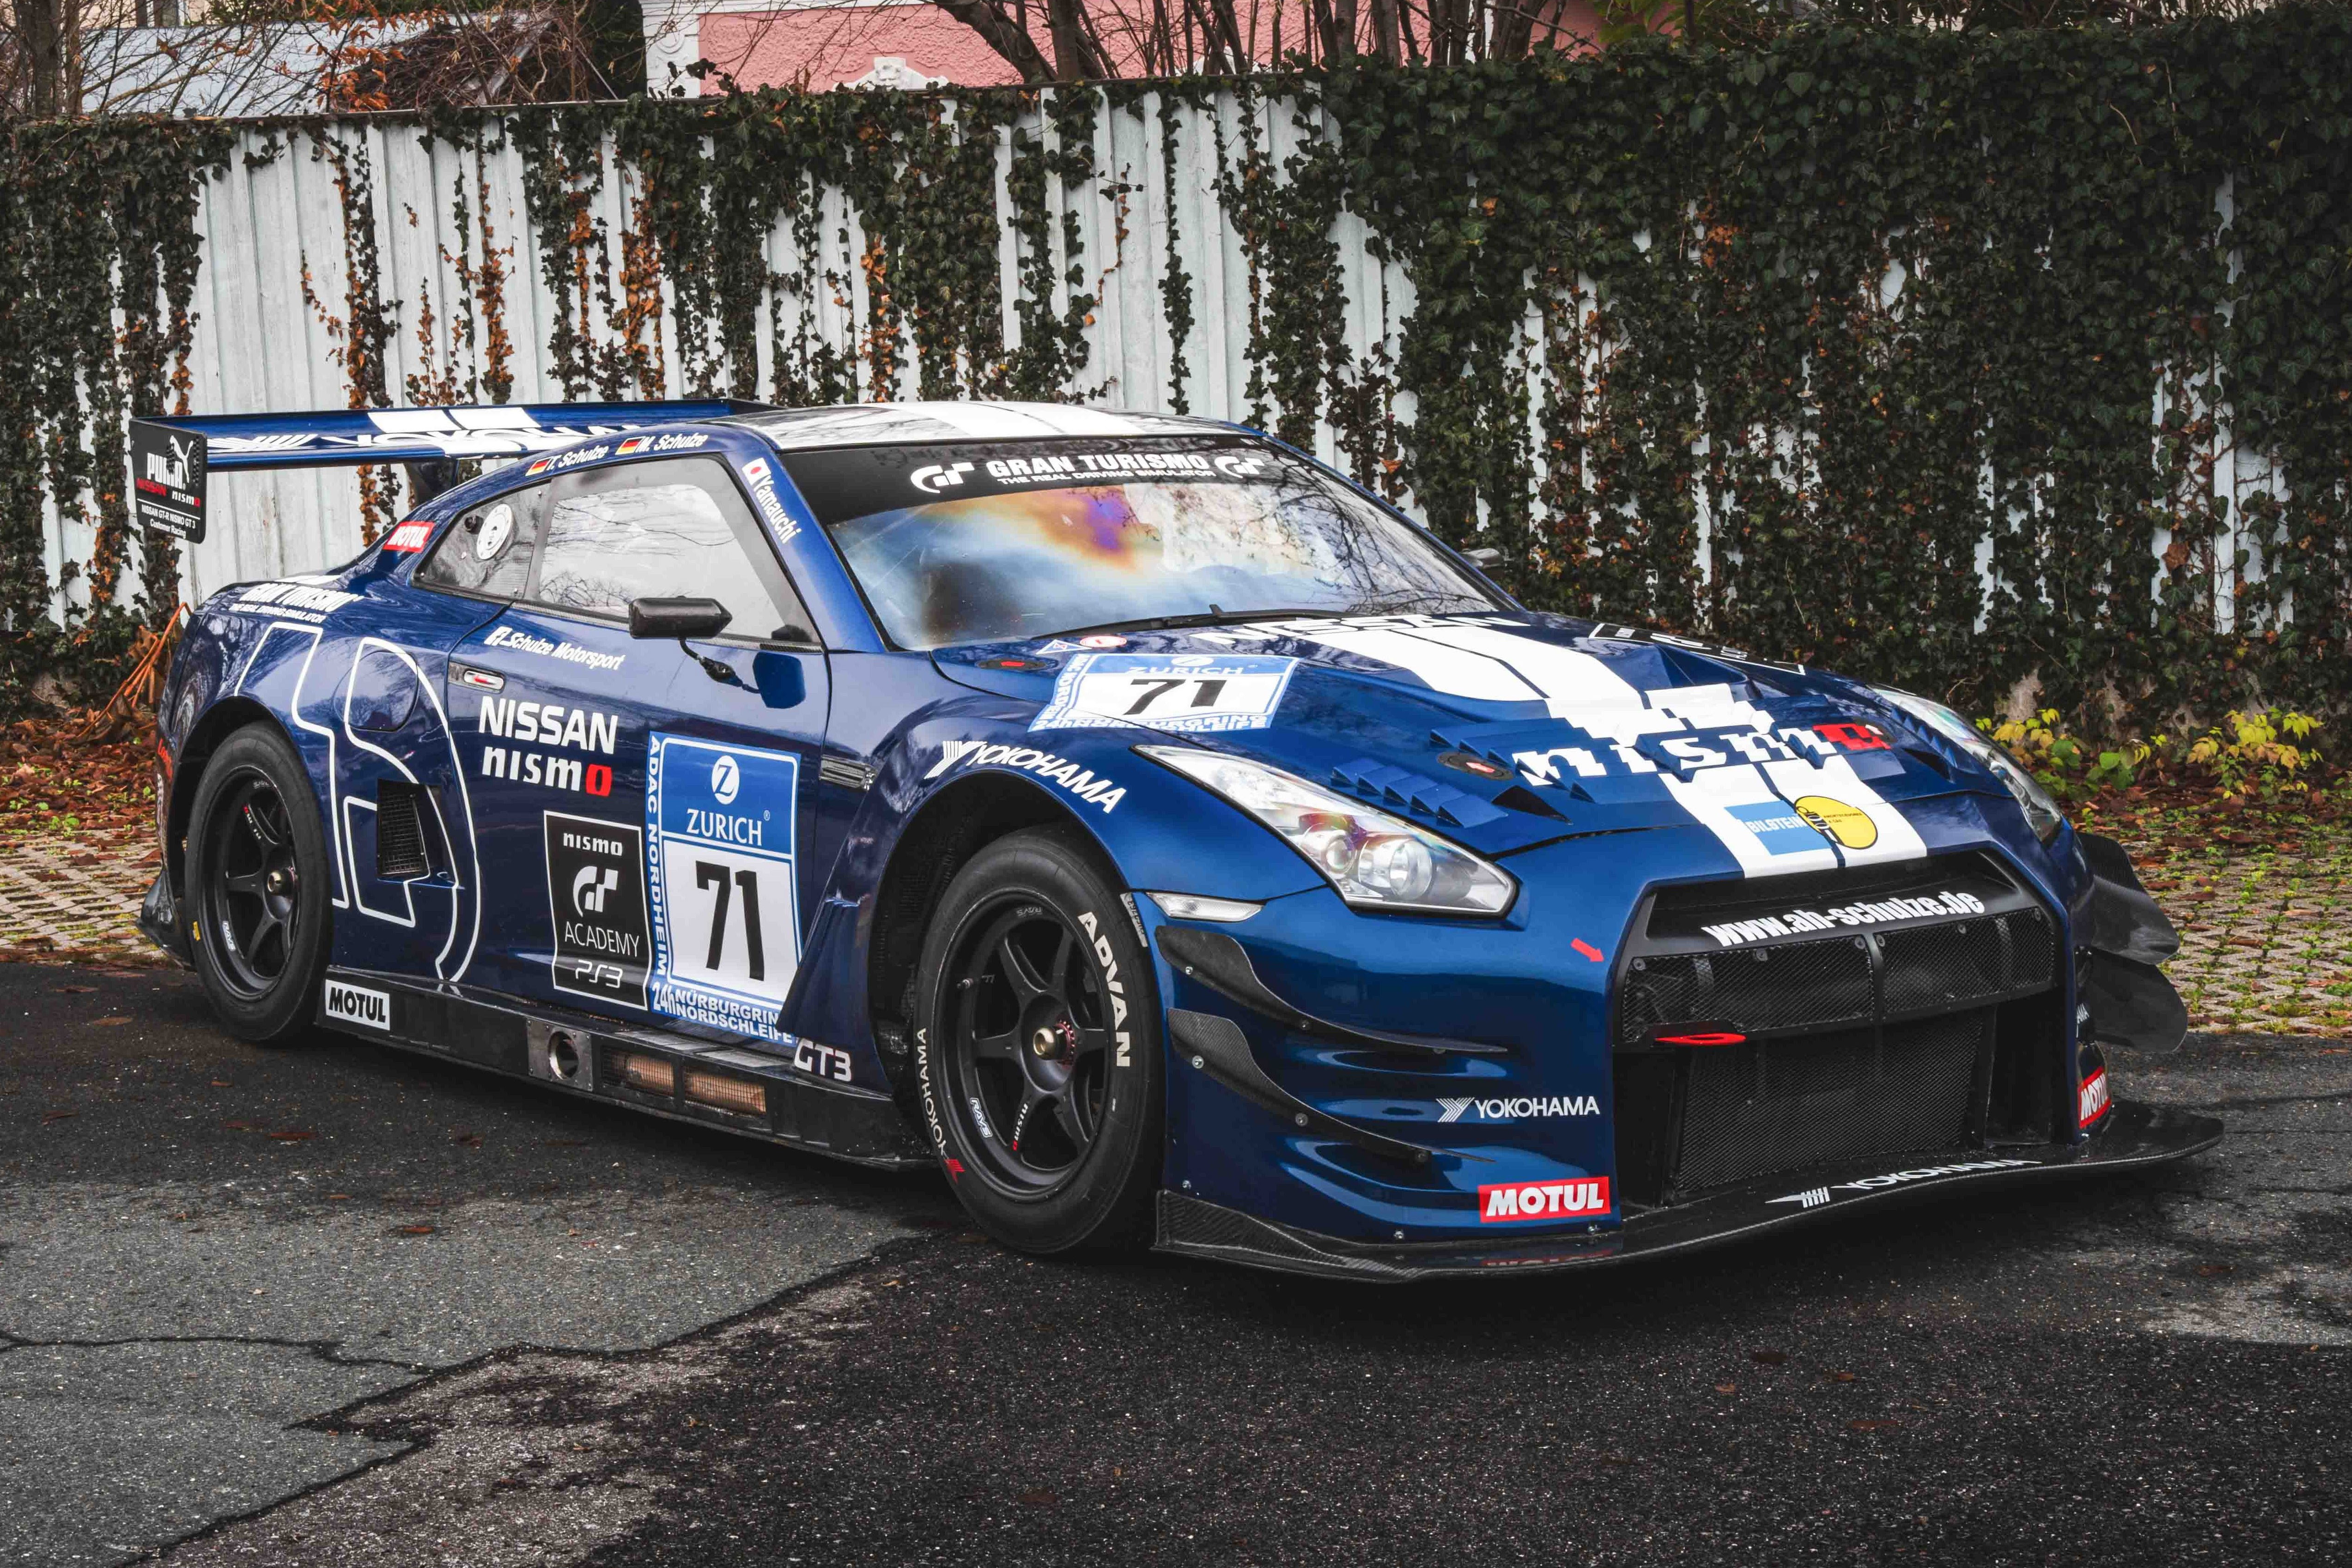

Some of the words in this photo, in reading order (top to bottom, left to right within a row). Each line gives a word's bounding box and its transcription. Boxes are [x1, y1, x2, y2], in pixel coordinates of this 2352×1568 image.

[547, 455, 561, 471] T.
[558, 445, 608, 468] Schulze
[637, 436, 650, 452] M.
[654, 432, 708, 450] Schulze
[986, 456, 1076, 477] GRAN
[1078, 454, 1209, 470] TURISMO
[997, 476, 1031, 484] THE
[1072, 470, 1134, 478] DRIVING
[142, 504, 158, 518] NISSAN
[158, 509, 169, 521] GT-R
[170, 513, 184, 525] NISMO
[185, 518, 192, 527] GT
[752, 474, 802, 544] Yamauchi
[150, 519, 170, 532] Customer
[171, 525, 186, 539] Racing
[388, 526, 430, 548] MOTUL
[240, 583, 297, 603] GRAN
[276, 586, 358, 612] TURISMO
[282, 609, 326, 624] SIMULATOR
[1191, 614, 1531, 645] NISSAN
[552, 642, 626, 670] Motorsport
[1123, 679, 1227, 715] 71
[479, 696, 618, 755] NISSAN
[648, 735, 660, 814] ADAC
[966, 744, 1127, 814] YOKOHAMA
[687, 809, 762, 846] ZURICH
[1744, 815, 1808, 833] BILSTEIN
[648, 823, 668, 976] NORDHEIM
[696, 860, 765, 981] 71
[1701, 890, 1985, 947] www.ah-schulze.de
[565, 921, 640, 957] ACADEMY
[575, 959, 623, 988] PS3
[1078, 911, 1130, 1067] ADVAN
[328, 986, 386, 1023] MOTUL
[652, 981, 676, 1014] 24h
[676, 989, 781, 1025] NÜRBURGRIN
[794, 1038, 852, 1082] GT3
[917, 1028, 947, 1155] YOKOHAMA
[1475, 1096, 1600, 1119] YOKOHAMA
[1830, 1159, 2042, 1190] YOKOHAMA
[1486, 1183, 1604, 1217] MOTUL
